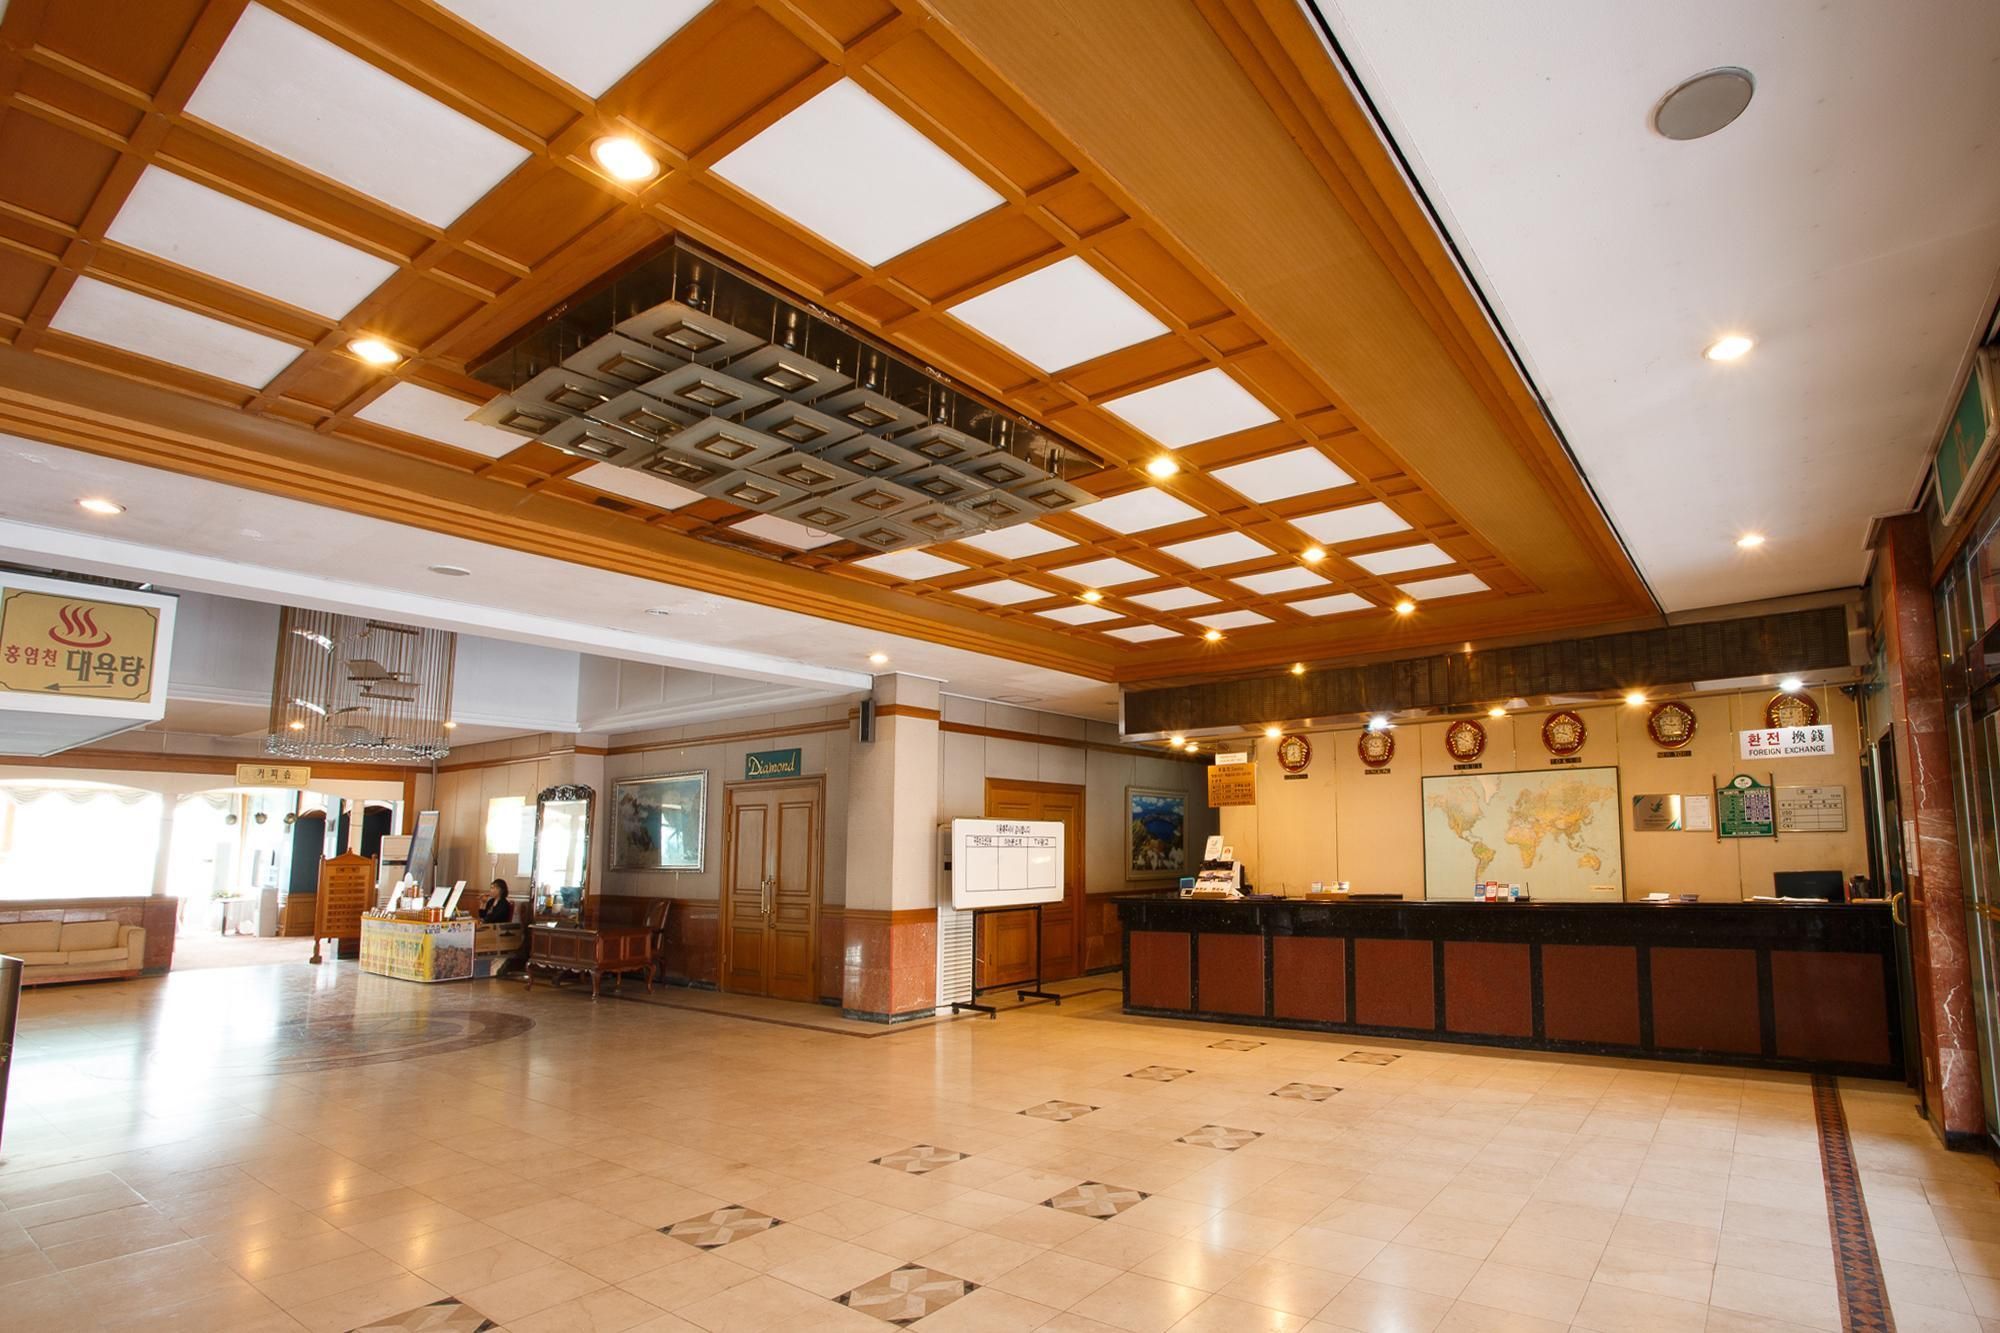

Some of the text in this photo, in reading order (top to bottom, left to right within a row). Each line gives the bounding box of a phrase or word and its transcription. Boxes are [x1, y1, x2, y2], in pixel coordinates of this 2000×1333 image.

[4, 645, 146, 687] 홍염천 대욕탕
[1748, 732, 1781, 747] 환전
[1749, 745, 1826, 756] FOREIGN EXCHANGE
[748, 752, 796, 776] Diamond
[257, 768, 291, 780] 커피숍
